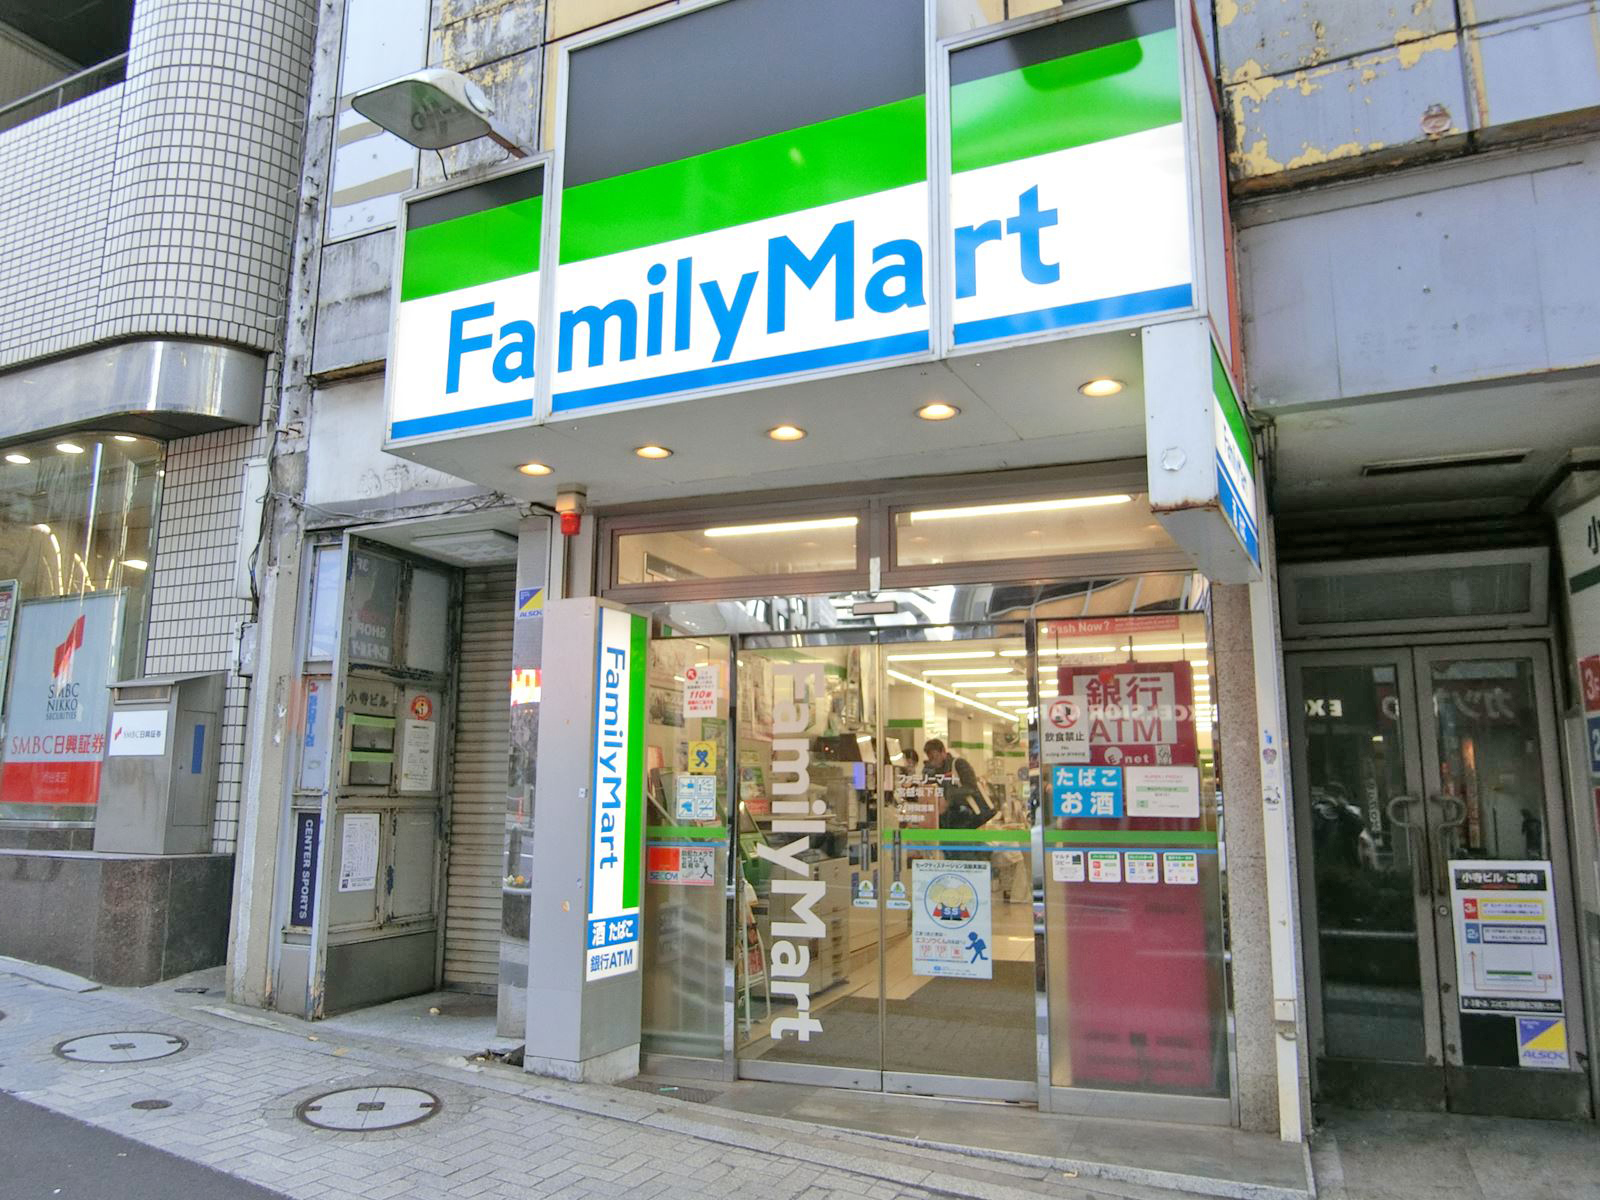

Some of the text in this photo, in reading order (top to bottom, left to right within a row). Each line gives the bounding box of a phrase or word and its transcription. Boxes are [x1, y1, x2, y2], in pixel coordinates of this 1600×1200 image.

[446, 184, 1061, 395] FamilyMart
[47, 698, 78, 713] NIKKO
[1086, 676, 1163, 713] 銀行
[1045, 732, 1085, 743] 飲食禁止
[1089, 717, 1164, 743] ATM
[11, 734, 105, 755] SMBC日興証券
[599, 646, 627, 870] FamilyMart
[1056, 767, 1118, 787] たばこ
[1061, 791, 1115, 816] お酒
[756, 662, 827, 1043] FamilyMart
[298, 818, 315, 920] CENTER SPORTS
[592, 919, 634, 947] 酒 たばこ
[590, 949, 633, 972] 銀行ATM
